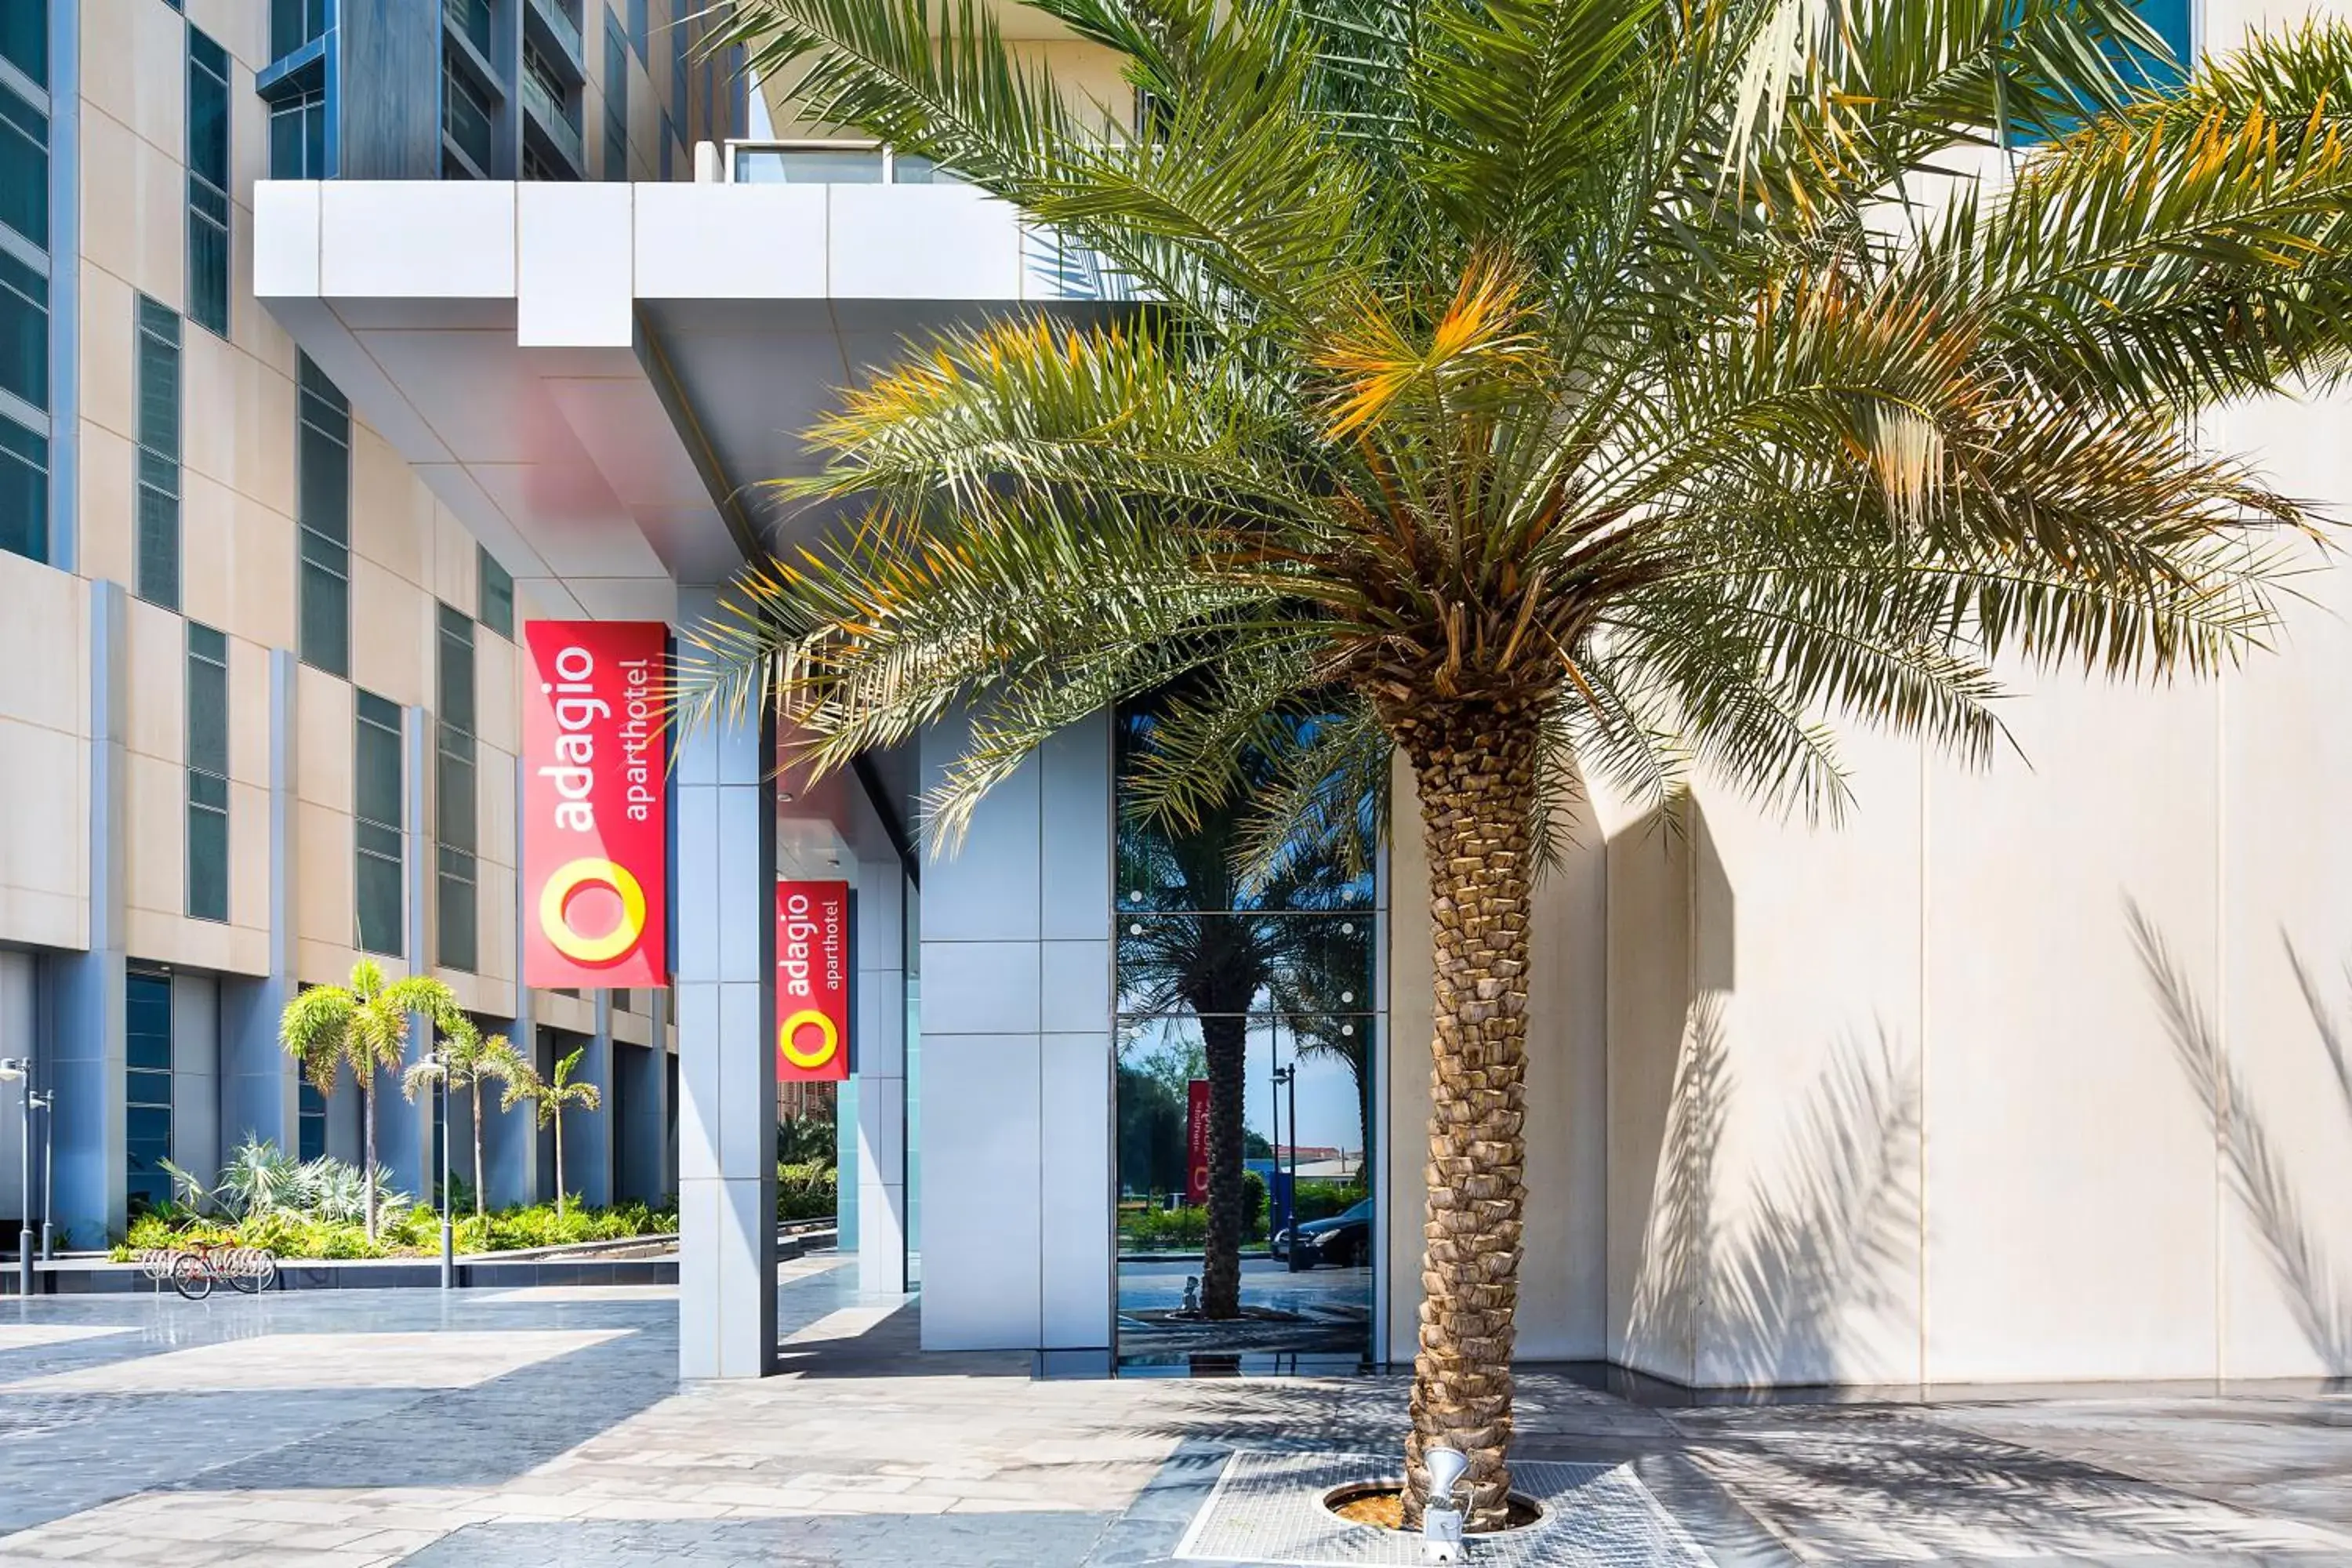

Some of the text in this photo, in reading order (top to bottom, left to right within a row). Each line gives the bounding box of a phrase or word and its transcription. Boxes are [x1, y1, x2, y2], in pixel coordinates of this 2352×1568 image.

[538, 646, 611, 832] adagio
[619, 659, 656, 821] aparthotel
[778, 895, 818, 996] adagio
[822, 901, 843, 989] aparthotel
